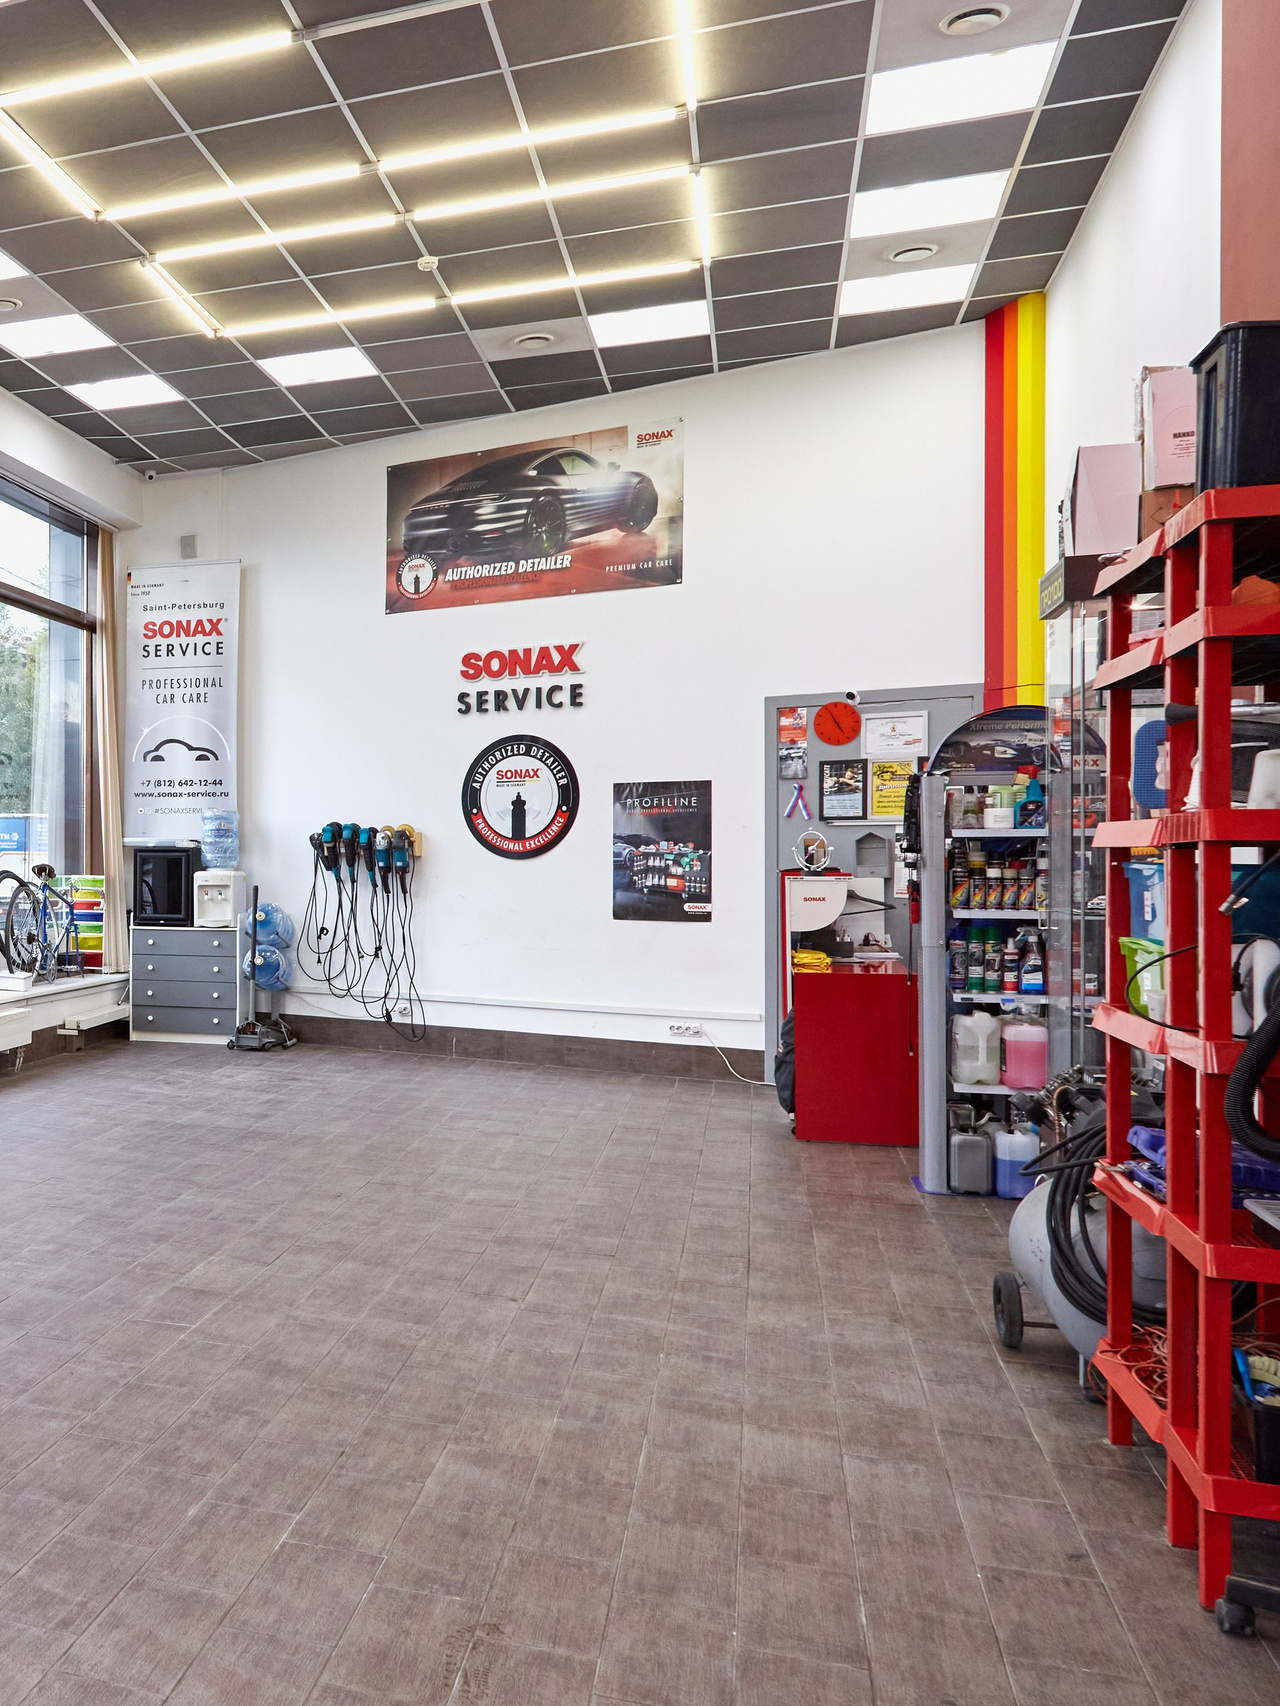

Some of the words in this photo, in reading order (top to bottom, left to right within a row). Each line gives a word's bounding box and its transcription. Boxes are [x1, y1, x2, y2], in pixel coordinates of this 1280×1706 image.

[637, 429, 673, 443] SONAX
[444, 561, 516, 582] AUTHORIZED
[518, 554, 572, 573] DETAILER
[605, 564, 636, 573] PREMIUM
[639, 561, 652, 569] CAR
[655, 558, 673, 567] CARE
[451, 578, 501, 590] PROFESSIONAL
[501, 572, 540, 583] EXCELLENCE
[142, 602, 225, 612] Saint-Petersburg
[142, 617, 224, 640] SONAX
[142, 641, 224, 658] SERVICE
[460, 642, 584, 681] SONAX
[141, 677, 224, 690] PROFESSIONAL
[155, 693, 176, 704] CAR
[181, 692, 209, 704] CARE
[457, 683, 584, 715] SERVICE
[471, 744, 526, 790] AUTHORIZED
[530, 745, 568, 787] DETAILER
[495, 768, 541, 780] SONAX
[153, 779, 176, 788] (812)
[177, 779, 223, 787] 642-12-44
[133, 789, 230, 798] www.sonax-service.ru
[626, 796, 698, 808] PROFILINE
[474, 817, 524, 851] PROFESSIONAL
[525, 816, 565, 851] EXCELLENCE
